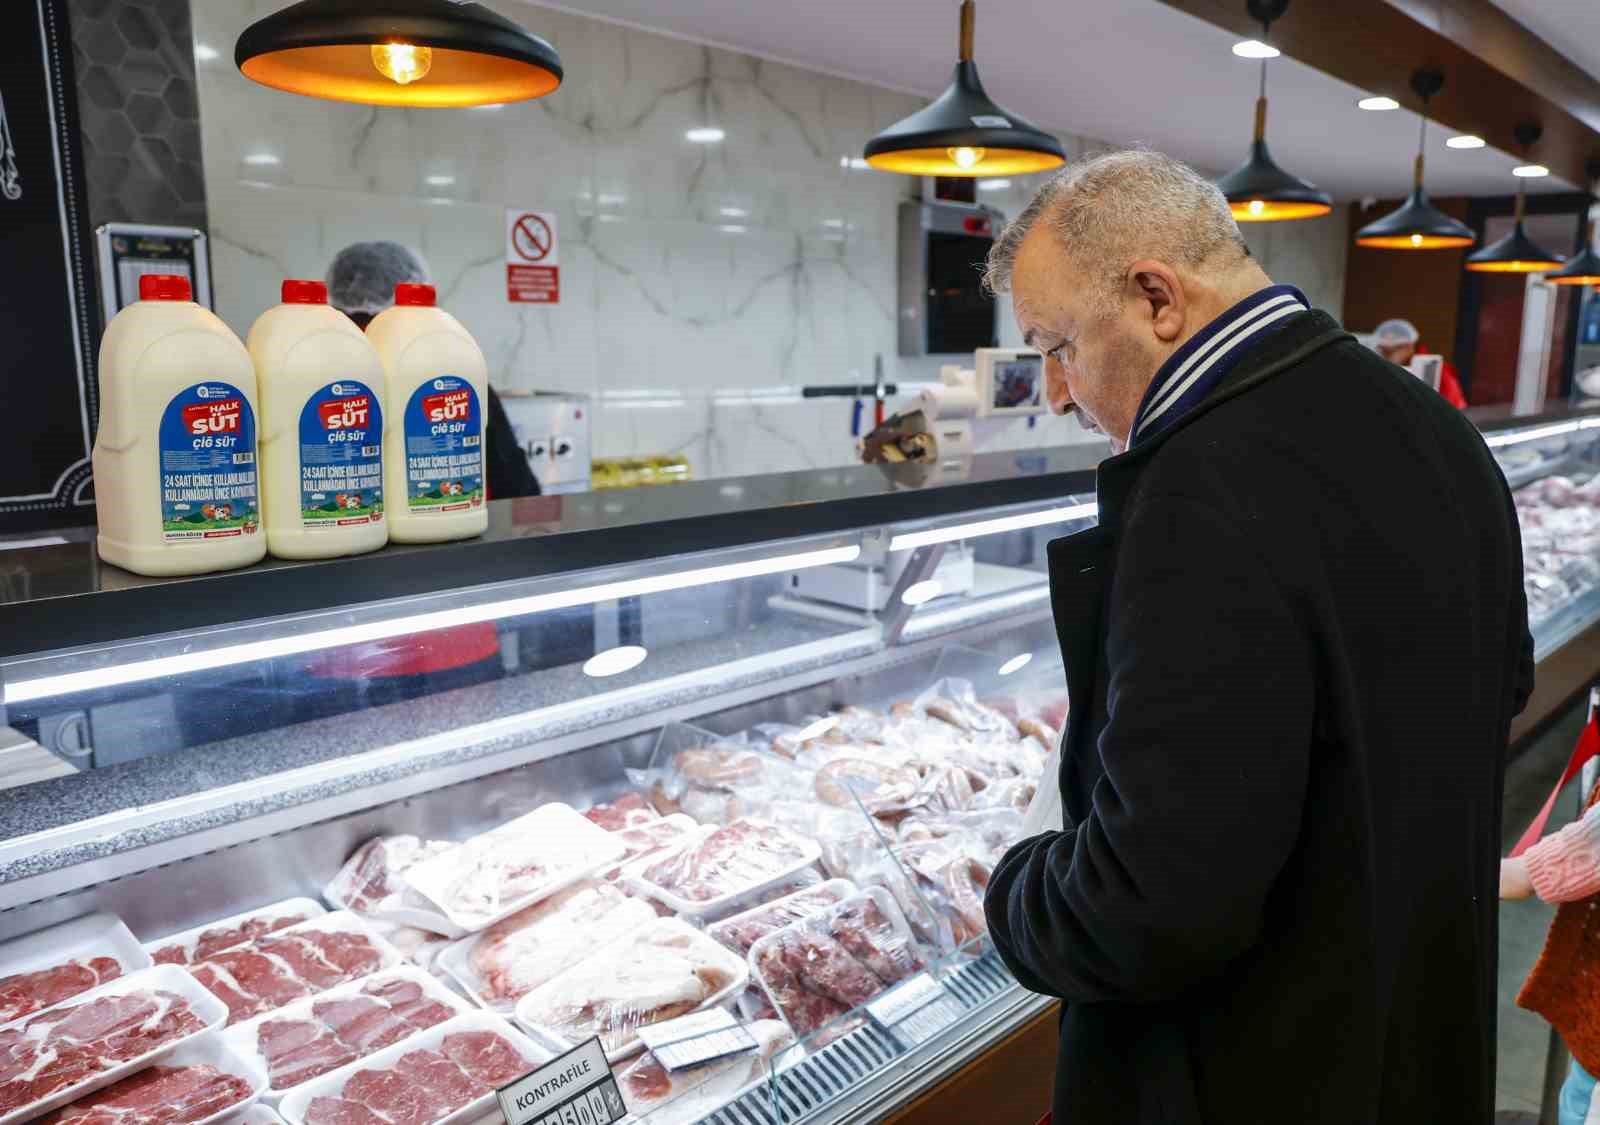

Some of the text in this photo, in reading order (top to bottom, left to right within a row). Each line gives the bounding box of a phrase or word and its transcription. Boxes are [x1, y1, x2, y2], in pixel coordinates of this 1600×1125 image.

[209, 401, 239, 413] HALK
[343, 398, 367, 410] HALK
[431, 402, 468, 422] SÜT
[192, 413, 239, 435] SÜT
[327, 408, 367, 429] SÜT
[215, 435, 236, 447] SÜT
[347, 430, 366, 441] SÜT
[164, 475, 174, 487] 24
[515, 1060, 591, 1110] KONTRAFİLE
